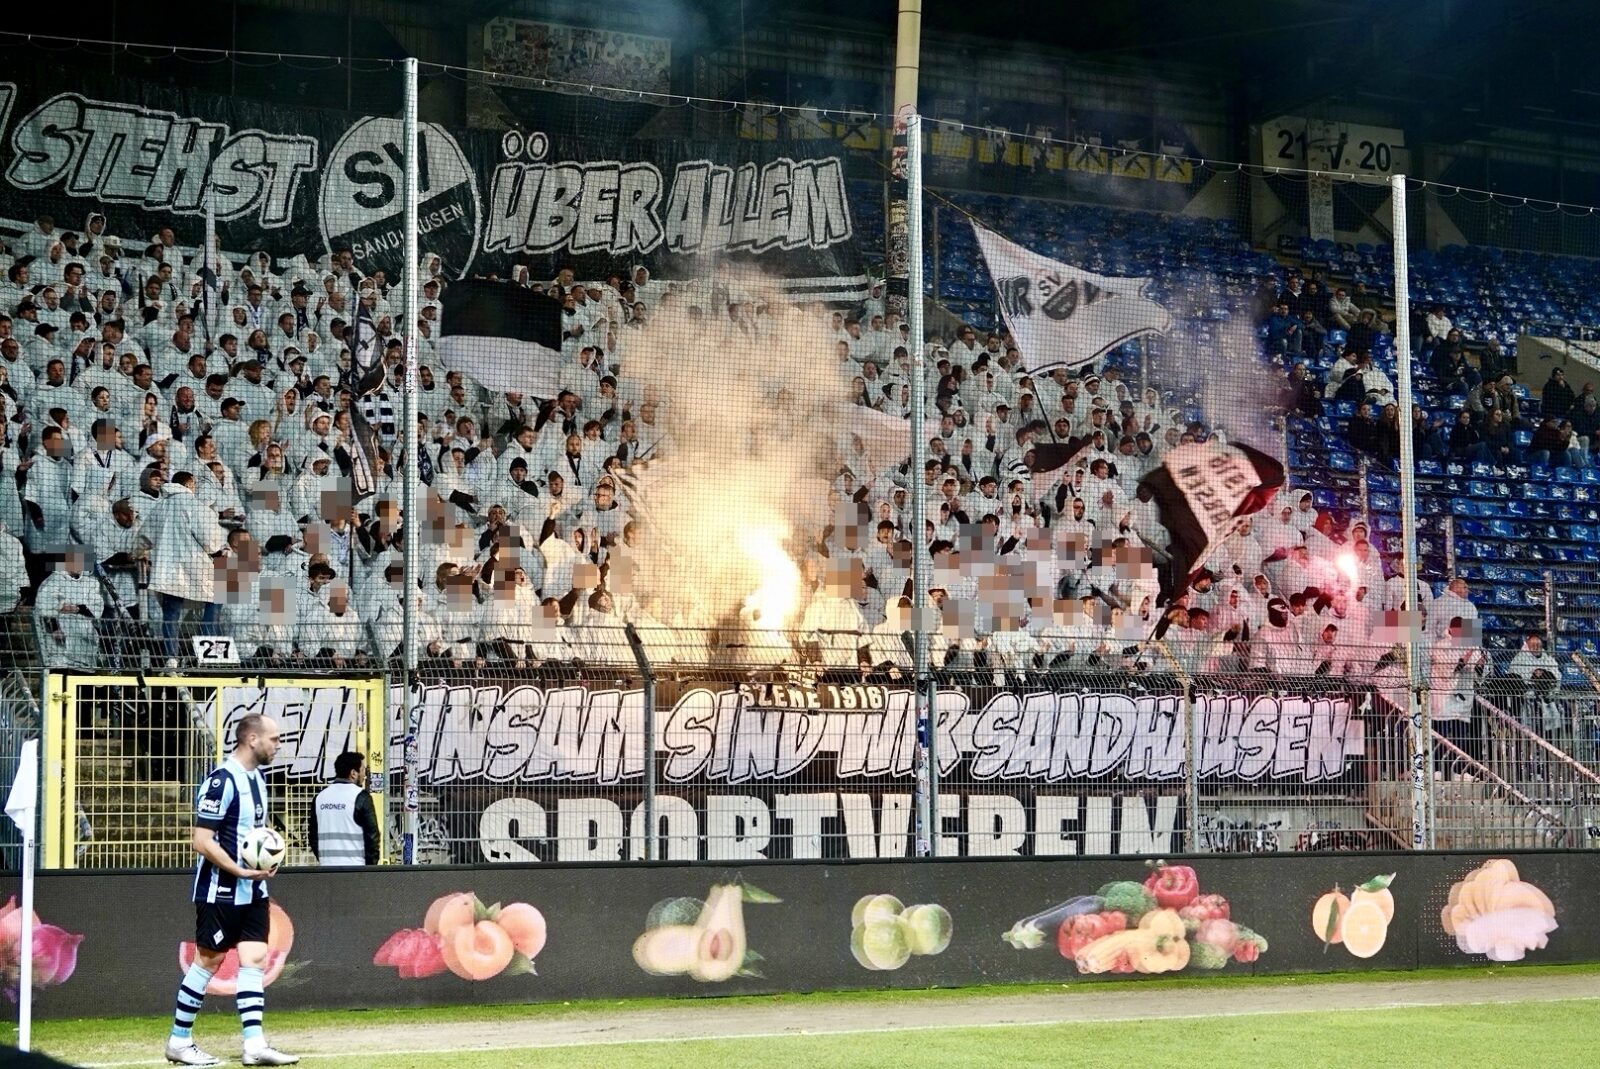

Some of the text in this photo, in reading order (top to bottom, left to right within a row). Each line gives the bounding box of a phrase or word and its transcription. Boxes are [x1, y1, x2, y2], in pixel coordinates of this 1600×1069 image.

[5, 92, 318, 229] STEHST
[483, 130, 665, 254] ÜBER
[664, 156, 853, 252] ALLEM
[344, 131, 430, 208] SV
[1359, 140, 1392, 172] 20
[352, 202, 465, 260] SANDUSEN
[199, 641, 231, 660] 27
[739, 684, 883, 708] SZENE 1916
[663, 688, 829, 784] SIND
[837, 690, 970, 779] WIR
[969, 691, 1354, 783] SANDHAUSEN
[320, 802, 347, 811] ORDNER
